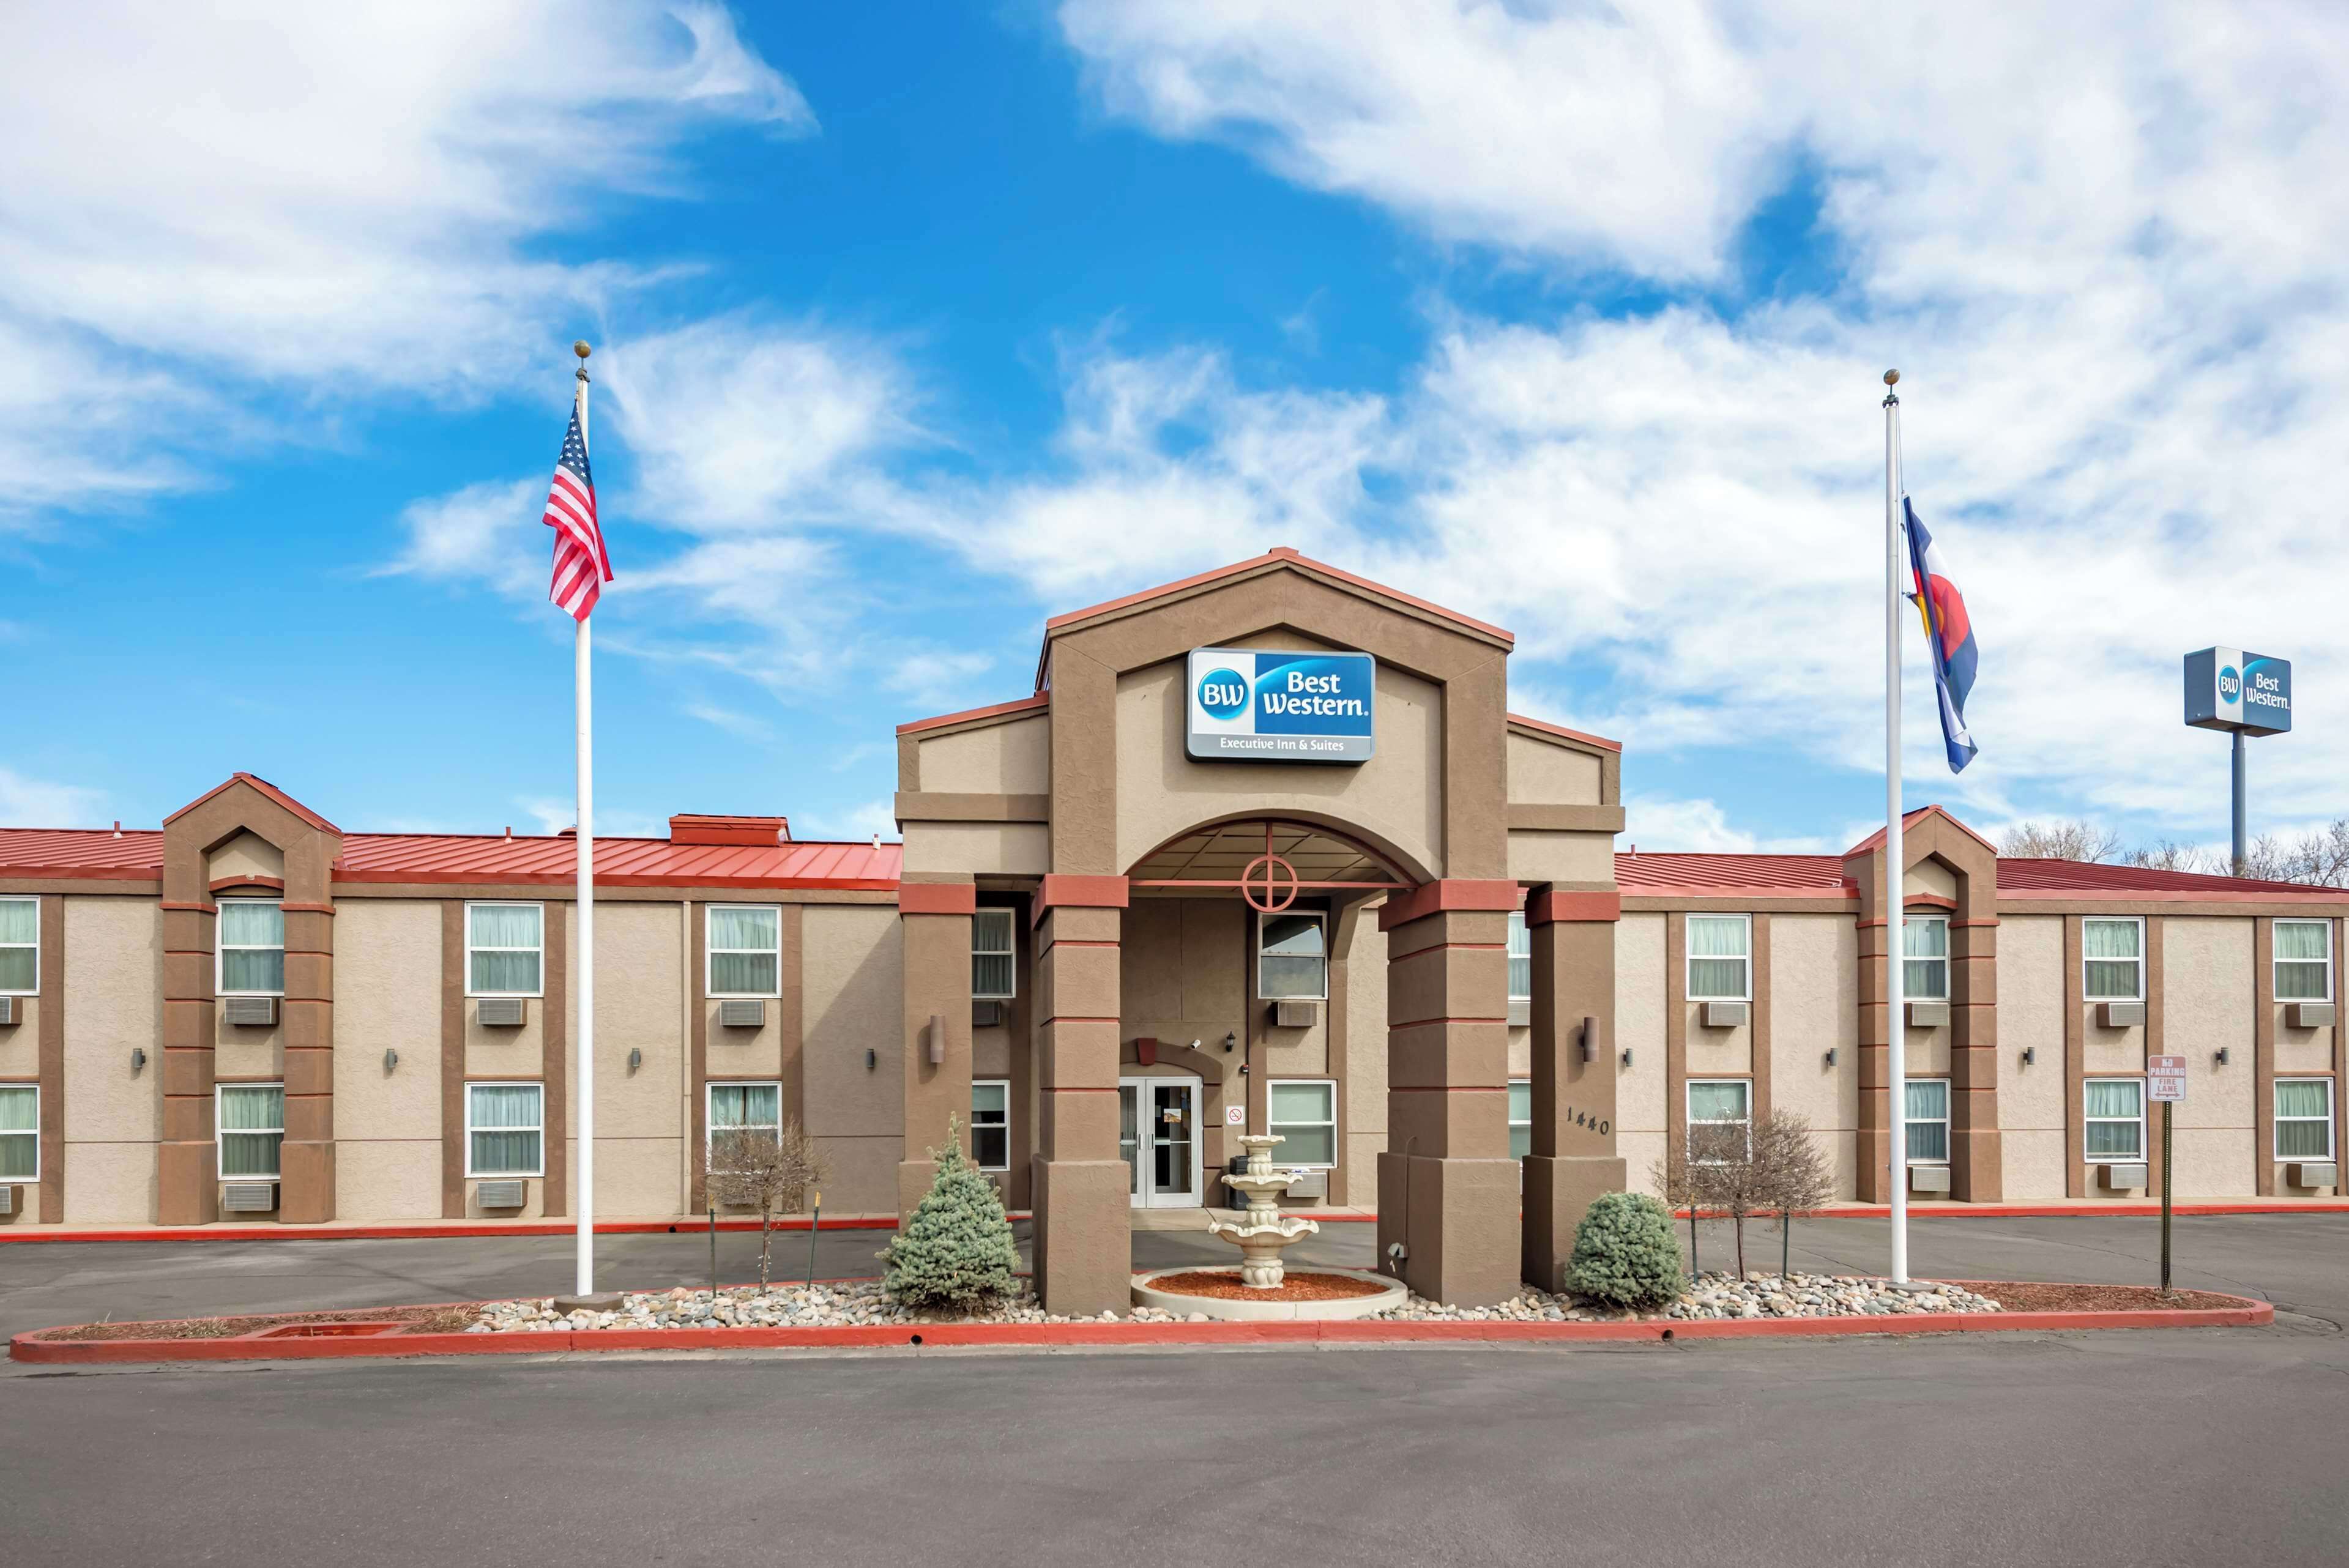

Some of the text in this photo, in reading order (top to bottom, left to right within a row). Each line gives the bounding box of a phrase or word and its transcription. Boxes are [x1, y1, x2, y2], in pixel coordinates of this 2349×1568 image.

[1287, 671, 1341, 694] Best
[2221, 676, 2238, 694] BW
[2256, 672, 2279, 692] Best
[1204, 684, 1245, 706] BW
[1220, 737, 1344, 751] Executive Inn & Suites
[2162, 1058, 2173, 1067] NO
[1567, 1106, 1609, 1135] 1440
